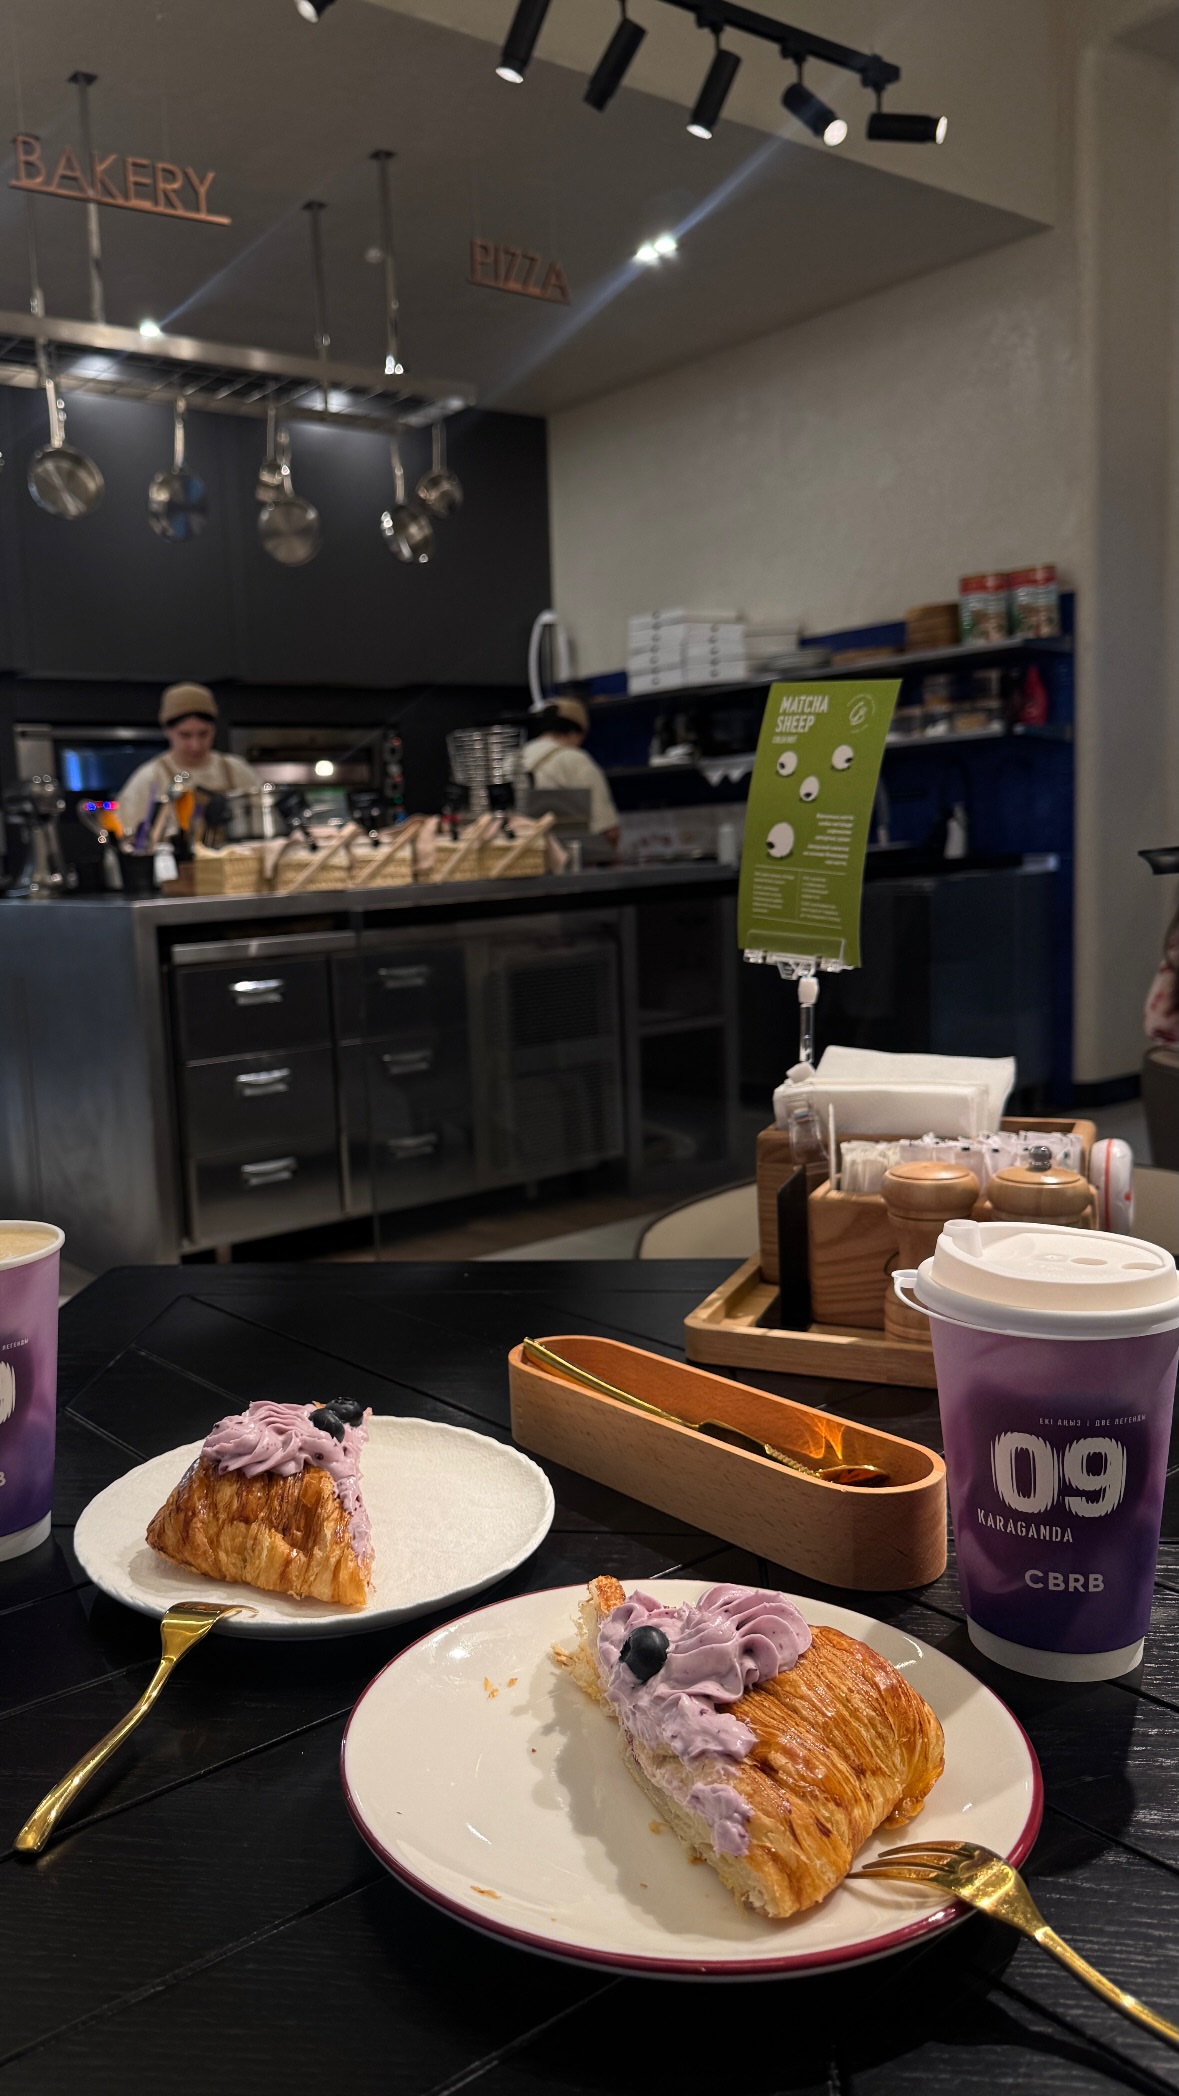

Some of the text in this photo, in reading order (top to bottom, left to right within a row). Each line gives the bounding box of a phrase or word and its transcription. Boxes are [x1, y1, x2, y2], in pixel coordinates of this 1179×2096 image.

[13, 133, 217, 215] BAKERY
[471, 239, 571, 301] PIZZA
[779, 695, 829, 713] MATCHA
[775, 714, 816, 733] SHEEP
[1095, 1419, 1111, 1427] ДВЕ
[990, 1431, 1127, 1518] 09
[976, 1508, 1074, 1543] KARAGANDA
[1024, 1569, 1105, 1593] CBRB
